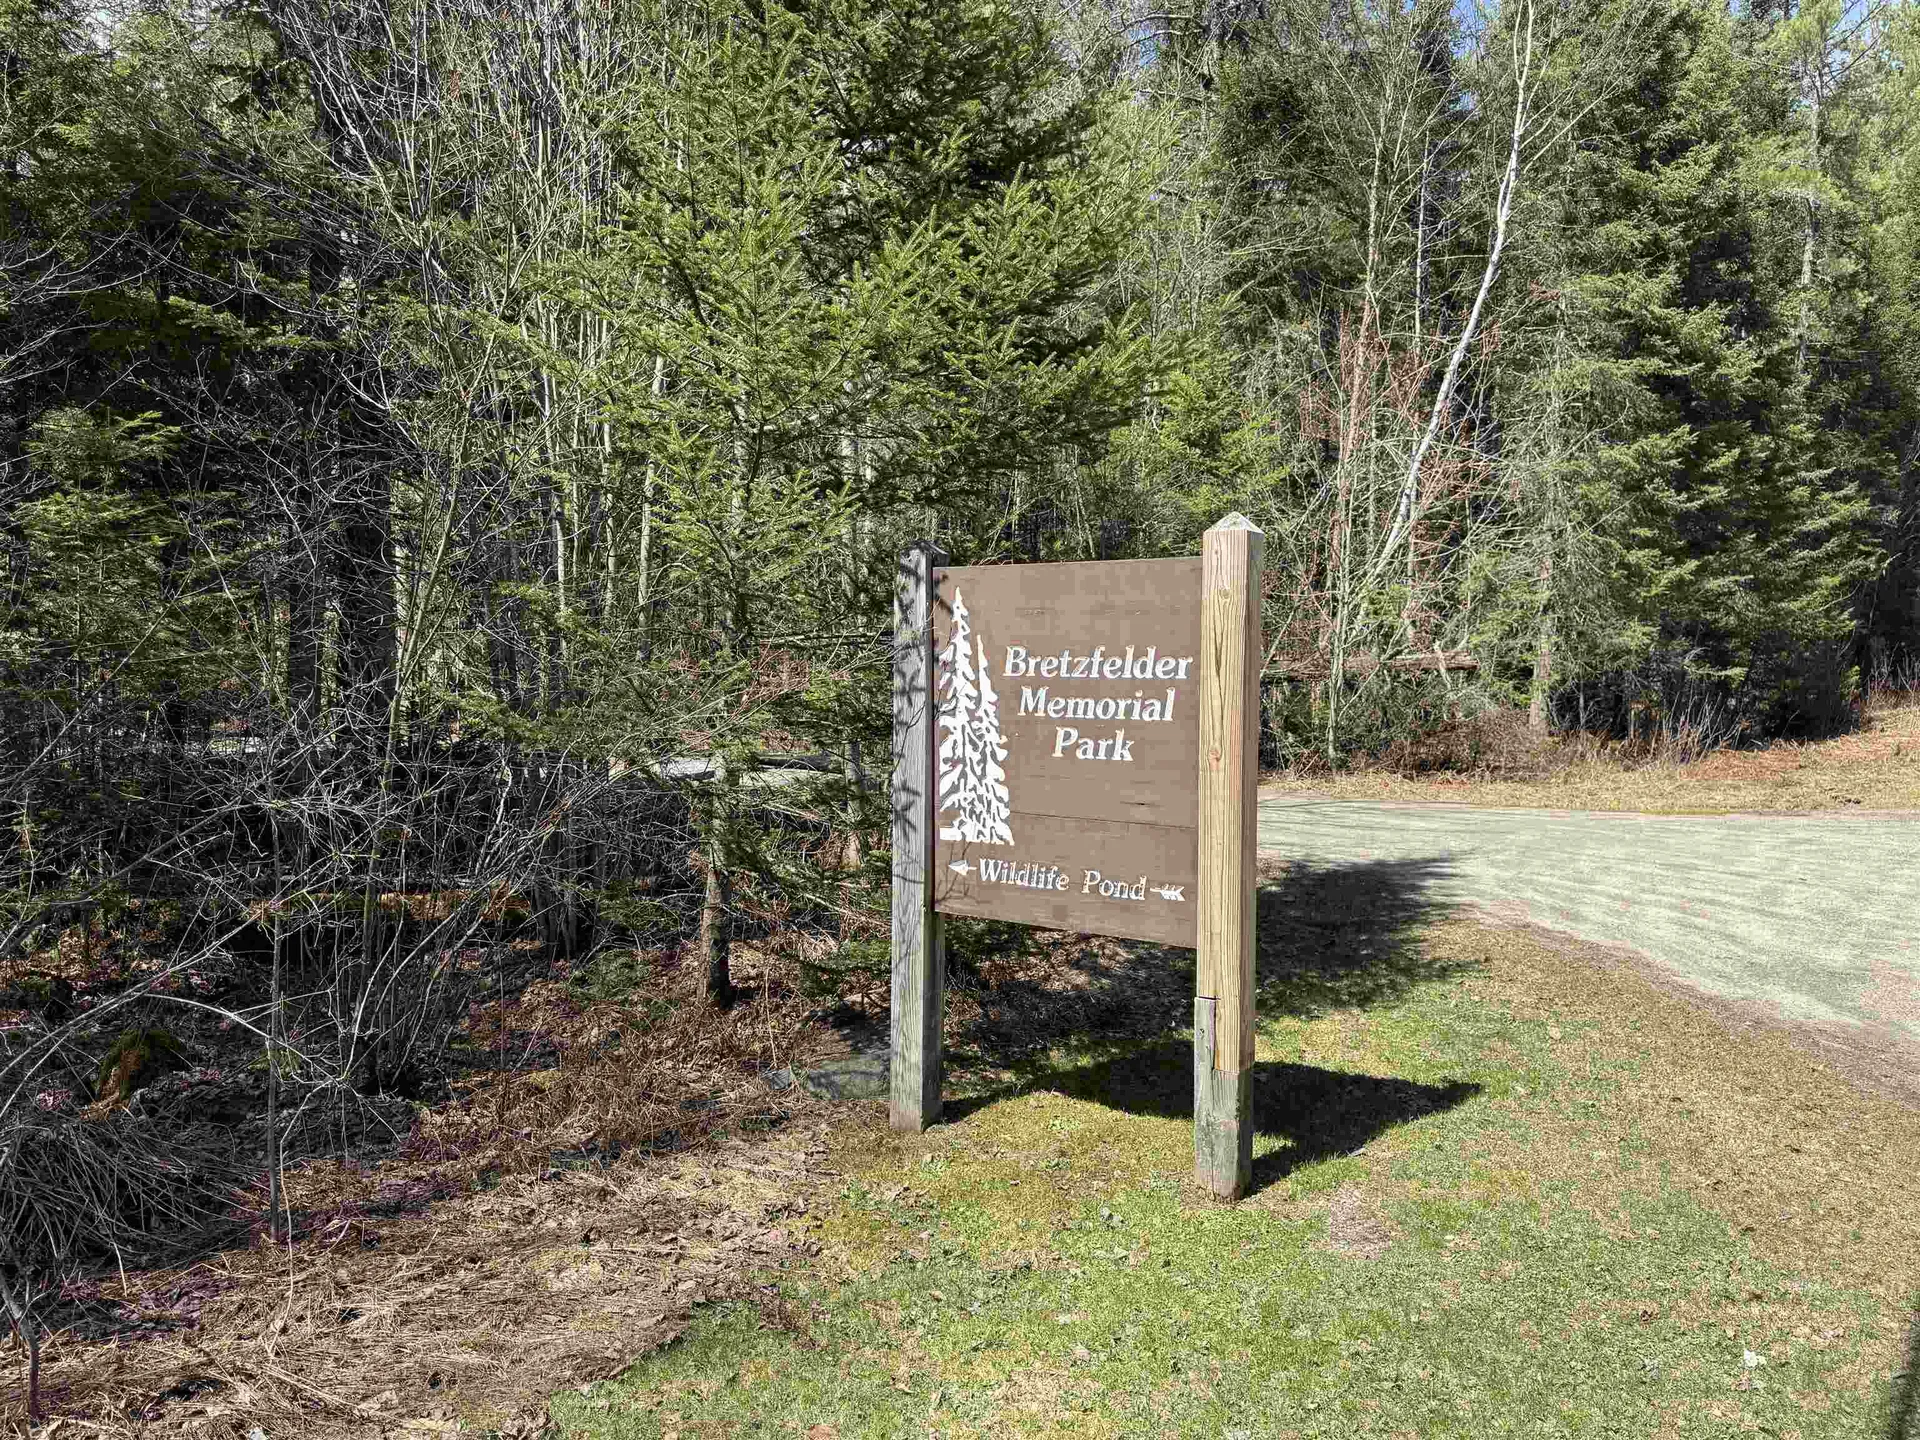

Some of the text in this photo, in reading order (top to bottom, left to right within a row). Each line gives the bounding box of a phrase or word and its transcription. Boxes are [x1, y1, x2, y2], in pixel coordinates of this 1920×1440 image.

[1002, 644, 1194, 681] Bretzfelder
[1017, 685, 1176, 722] Memorial
[1051, 725, 1135, 763] Park
[979, 857, 1147, 901] Wildlife Pond
